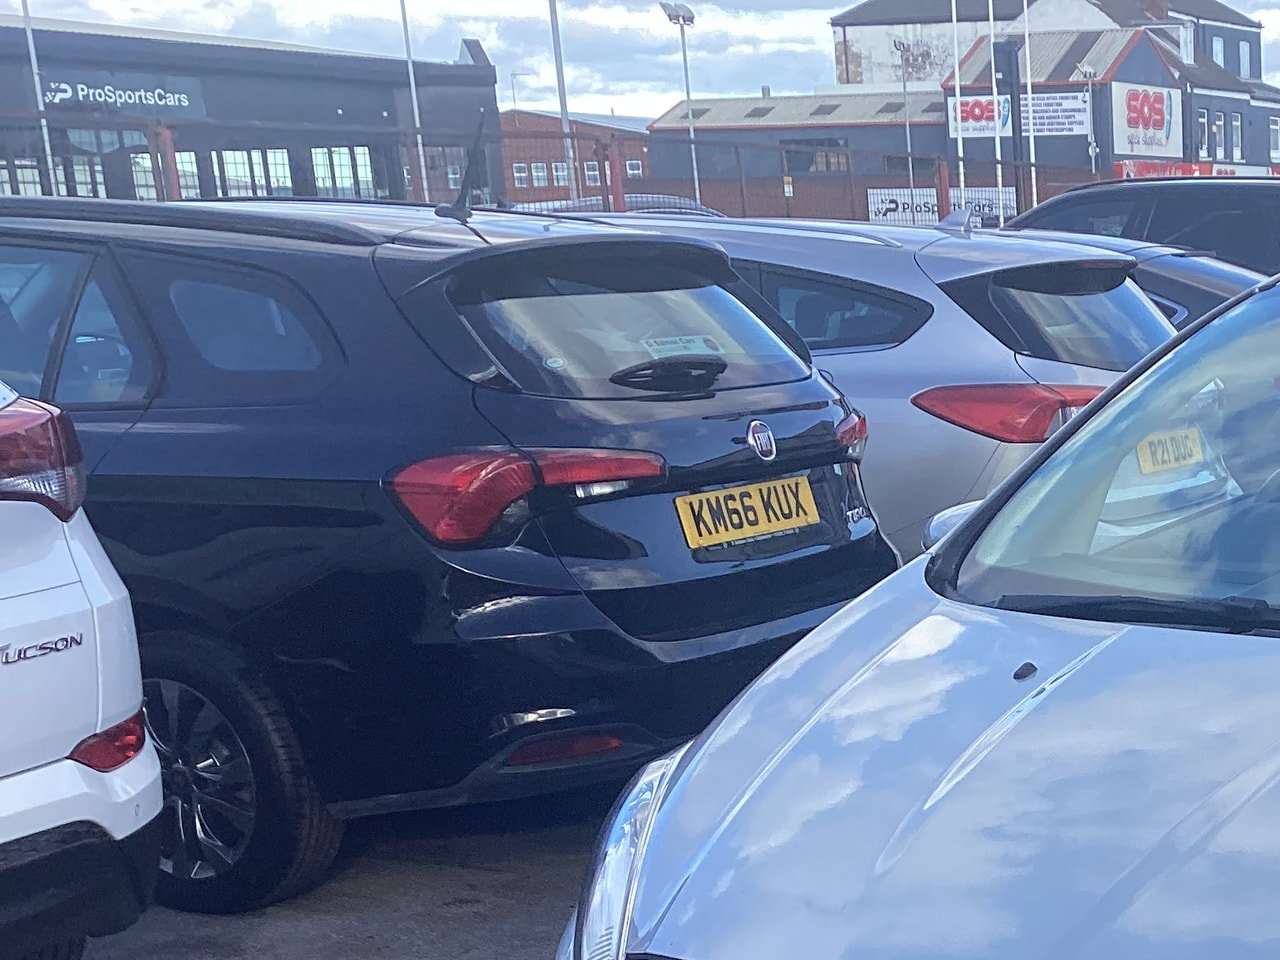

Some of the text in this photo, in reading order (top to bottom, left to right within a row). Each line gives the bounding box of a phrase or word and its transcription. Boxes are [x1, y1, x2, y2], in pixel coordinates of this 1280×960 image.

[76, 84, 190, 107] ProSportsCars
[1126, 89, 1166, 131] SOS
[689, 481, 808, 538] KM66 KUX
